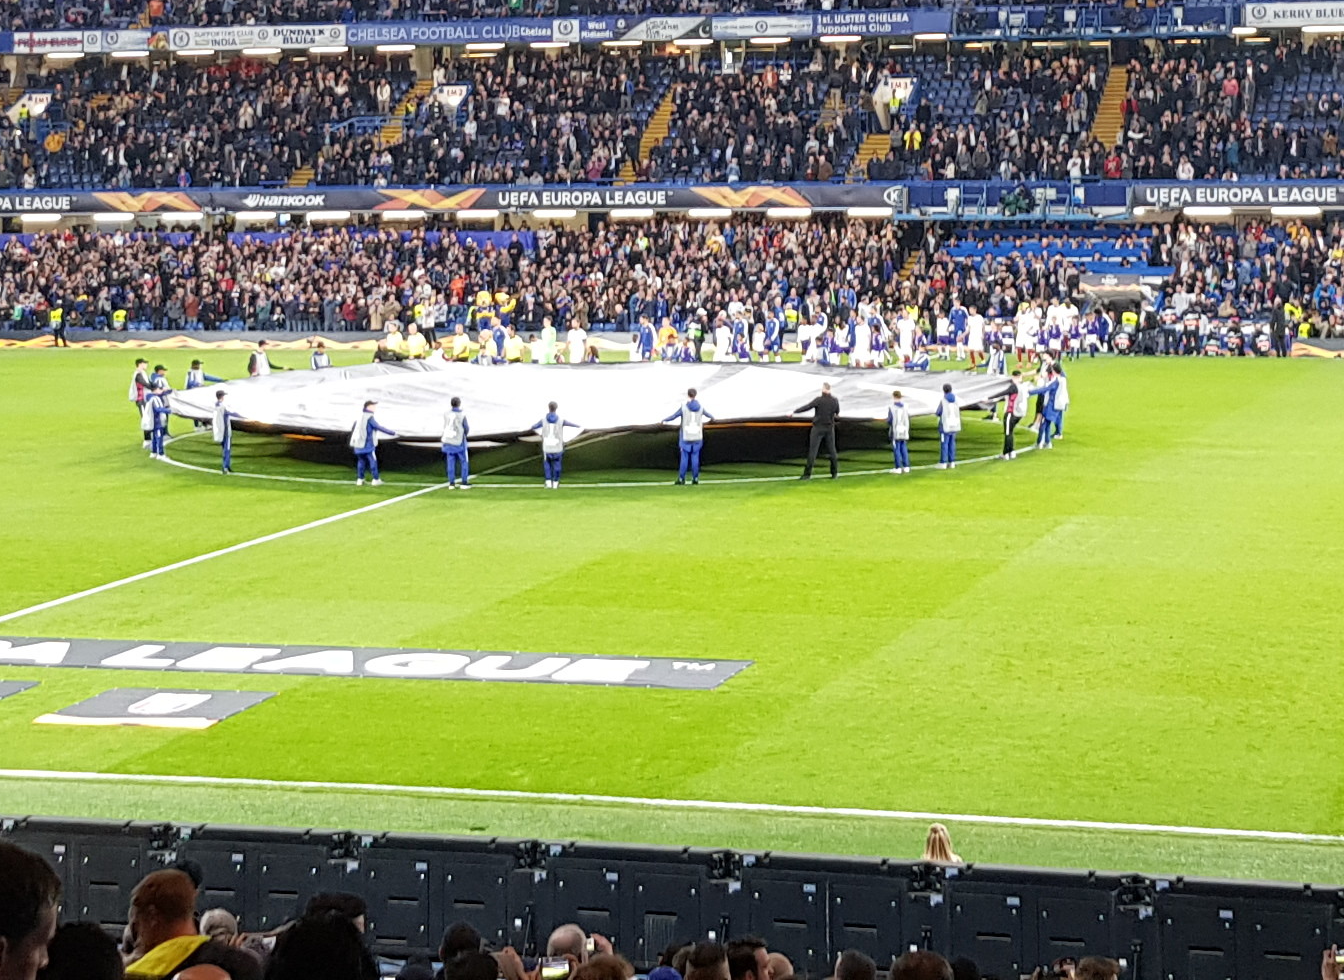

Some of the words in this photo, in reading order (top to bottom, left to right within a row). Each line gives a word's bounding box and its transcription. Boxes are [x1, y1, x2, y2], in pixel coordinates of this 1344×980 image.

[835, 14, 866, 24] ULSTER
[868, 13, 909, 23] CHELSEA
[1273, 10, 1313, 20] KERRY
[273, 27, 326, 36] DUNDALK
[348, 28, 407, 42] CHELSEA
[411, 26, 479, 41] FOOTBALL
[482, 24, 520, 39] CLUB
[817, 25, 866, 34] Supporters
[869, 23, 891, 32] Club
[211, 37, 238, 47] INDIA
[282, 36, 316, 45] BLUES
[498, 192, 538, 205] UEFA
[542, 192, 602, 205] EUROPA
[605, 191, 666, 204] LEAGUE
[1146, 188, 1191, 204] UEFA
[1196, 188, 1264, 203] EUROPA
[1268, 187, 1337, 202] LEAGUE
[15, 197, 71, 210] LEAGUE
[102, 642, 650, 684] LEAGUE
